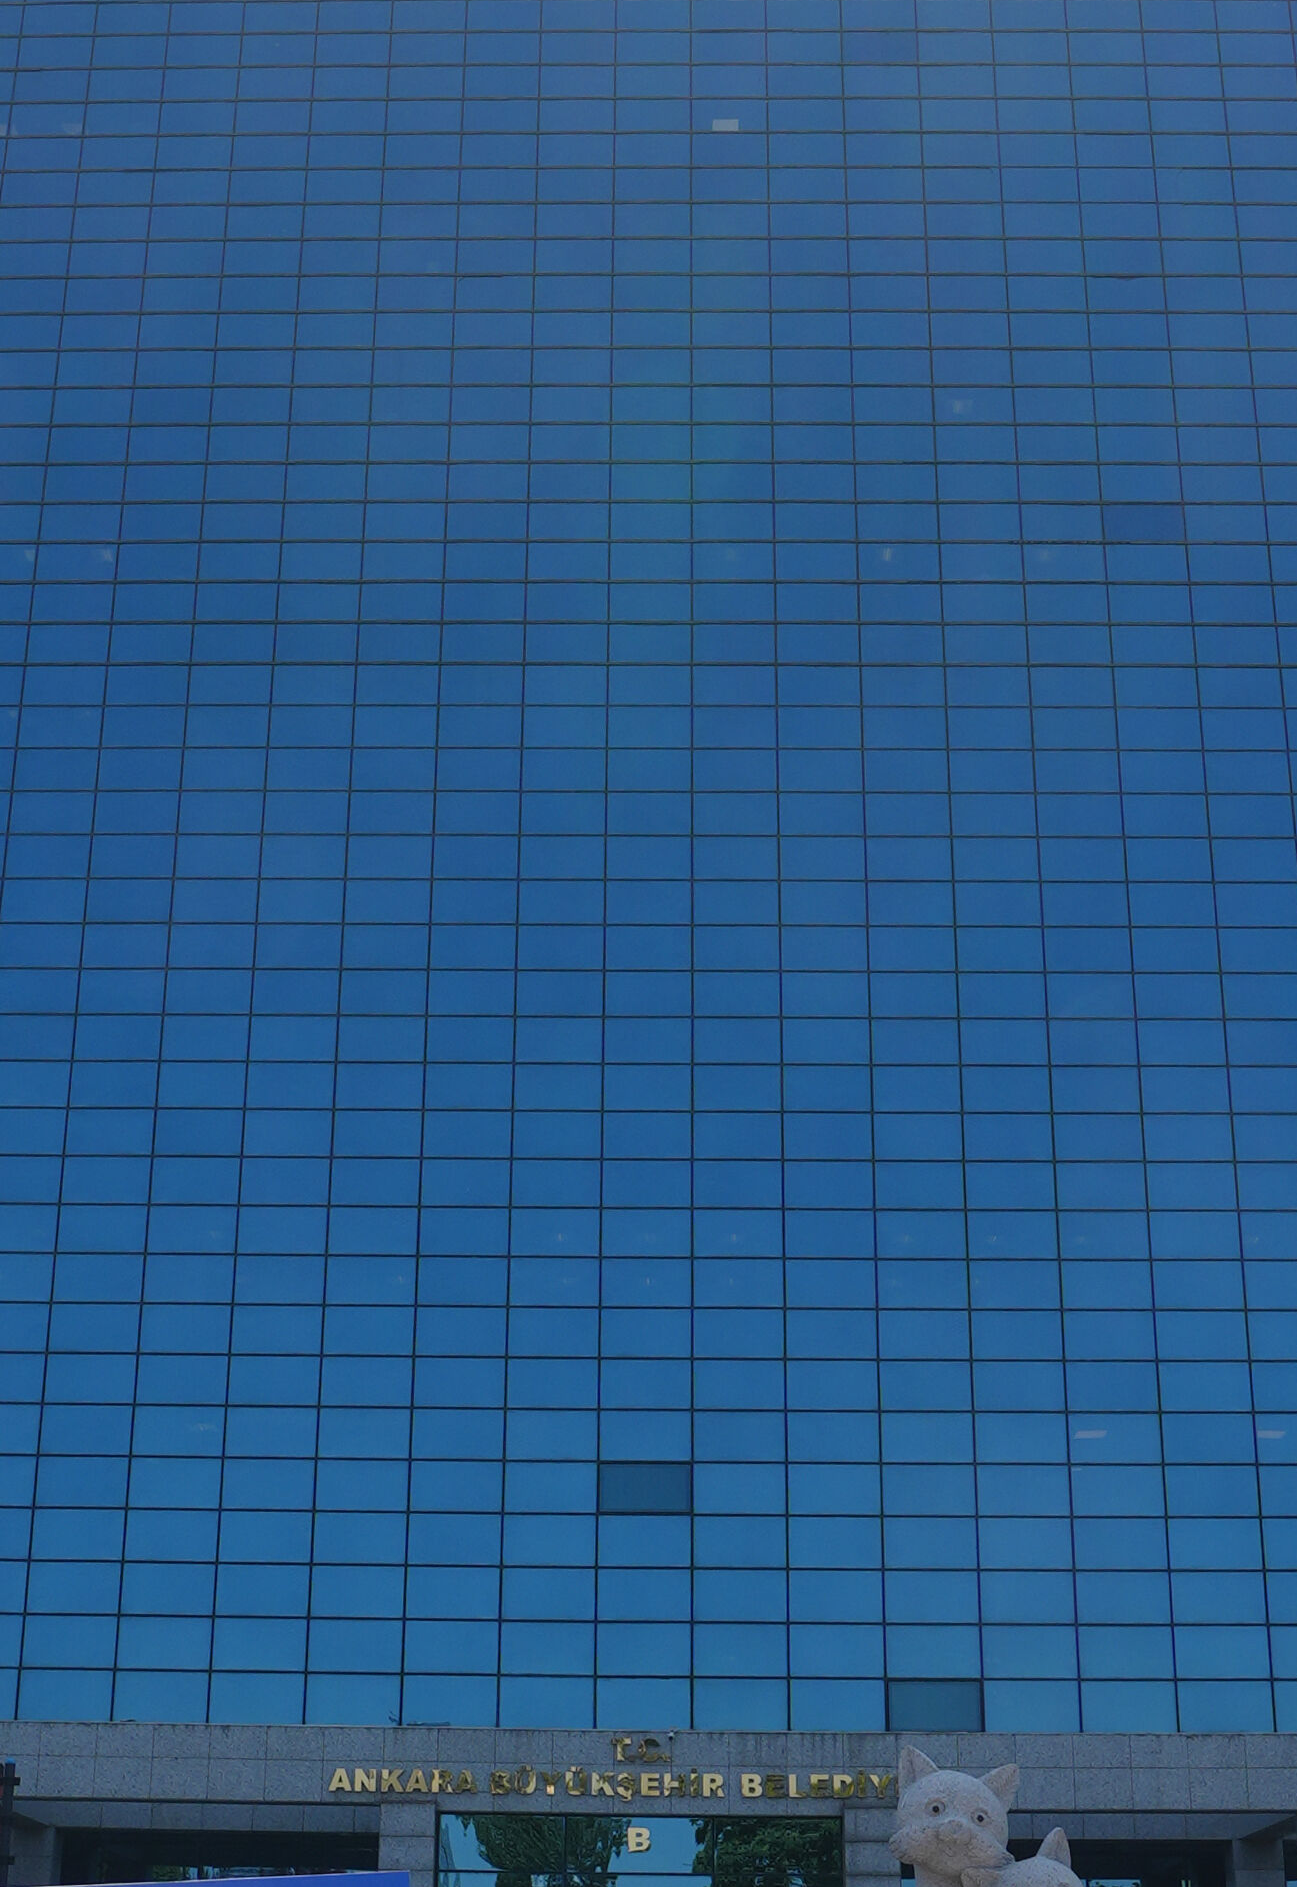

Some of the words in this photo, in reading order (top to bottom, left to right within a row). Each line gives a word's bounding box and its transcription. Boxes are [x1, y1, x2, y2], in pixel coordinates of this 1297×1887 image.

[328, 1768, 478, 1794] ANKARA
[490, 1765, 724, 1801] BÜYÜKŞEHİR
[741, 1768, 900, 1799] BELEDİY
[626, 1826, 652, 1853] B
